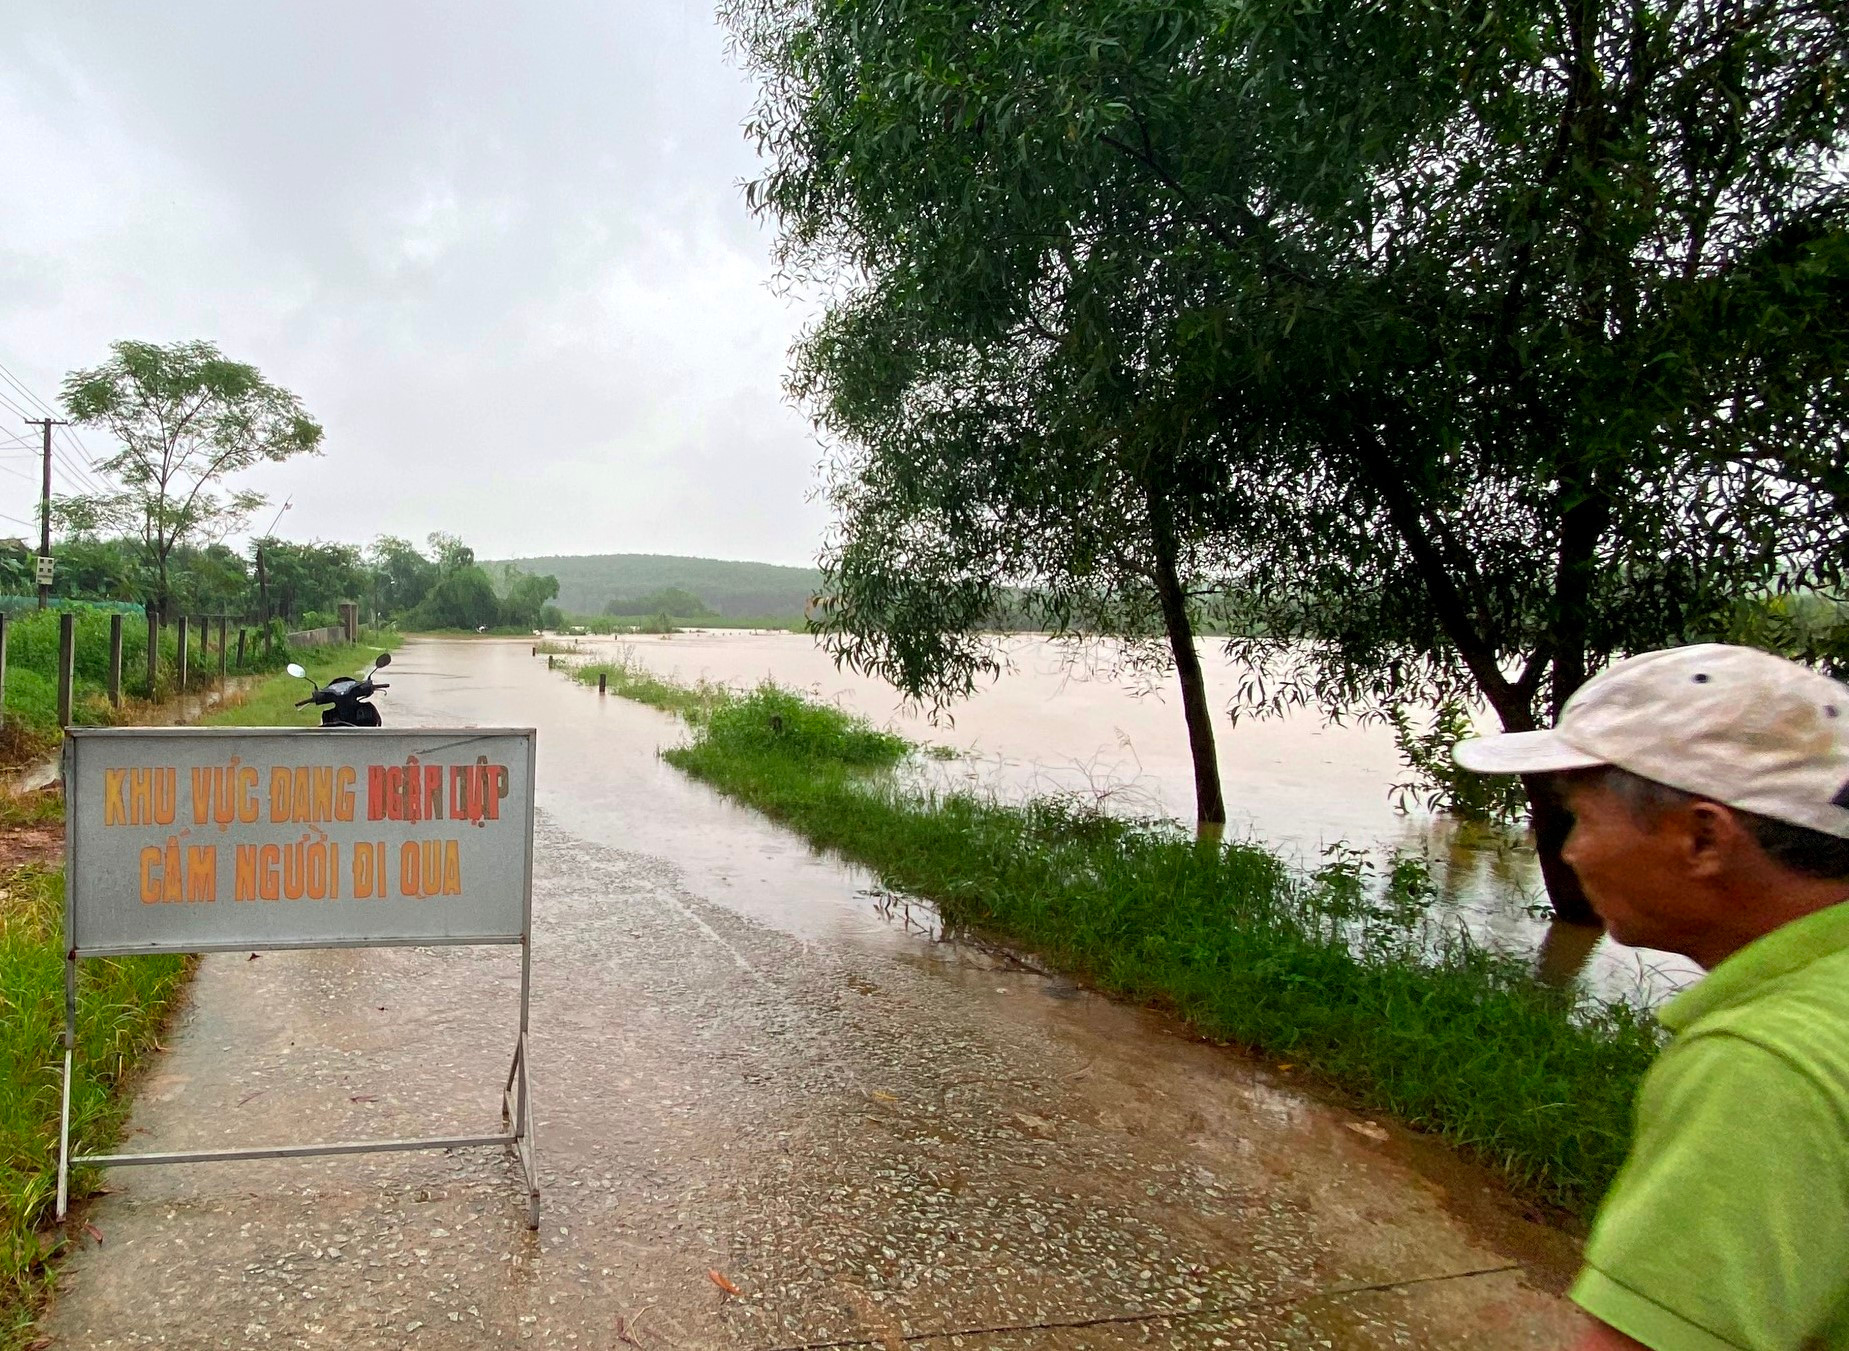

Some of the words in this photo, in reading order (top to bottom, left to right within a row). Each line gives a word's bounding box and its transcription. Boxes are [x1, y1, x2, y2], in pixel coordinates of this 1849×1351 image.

[105, 768, 176, 826] KHU
[192, 756, 259, 832] VỰC
[270, 766, 357, 823] ĐANG
[139, 828, 217, 904] CẤM
[235, 824, 339, 901] NGƯỜI
[352, 841, 387, 898] ĐI
[400, 840, 461, 899] QUA
